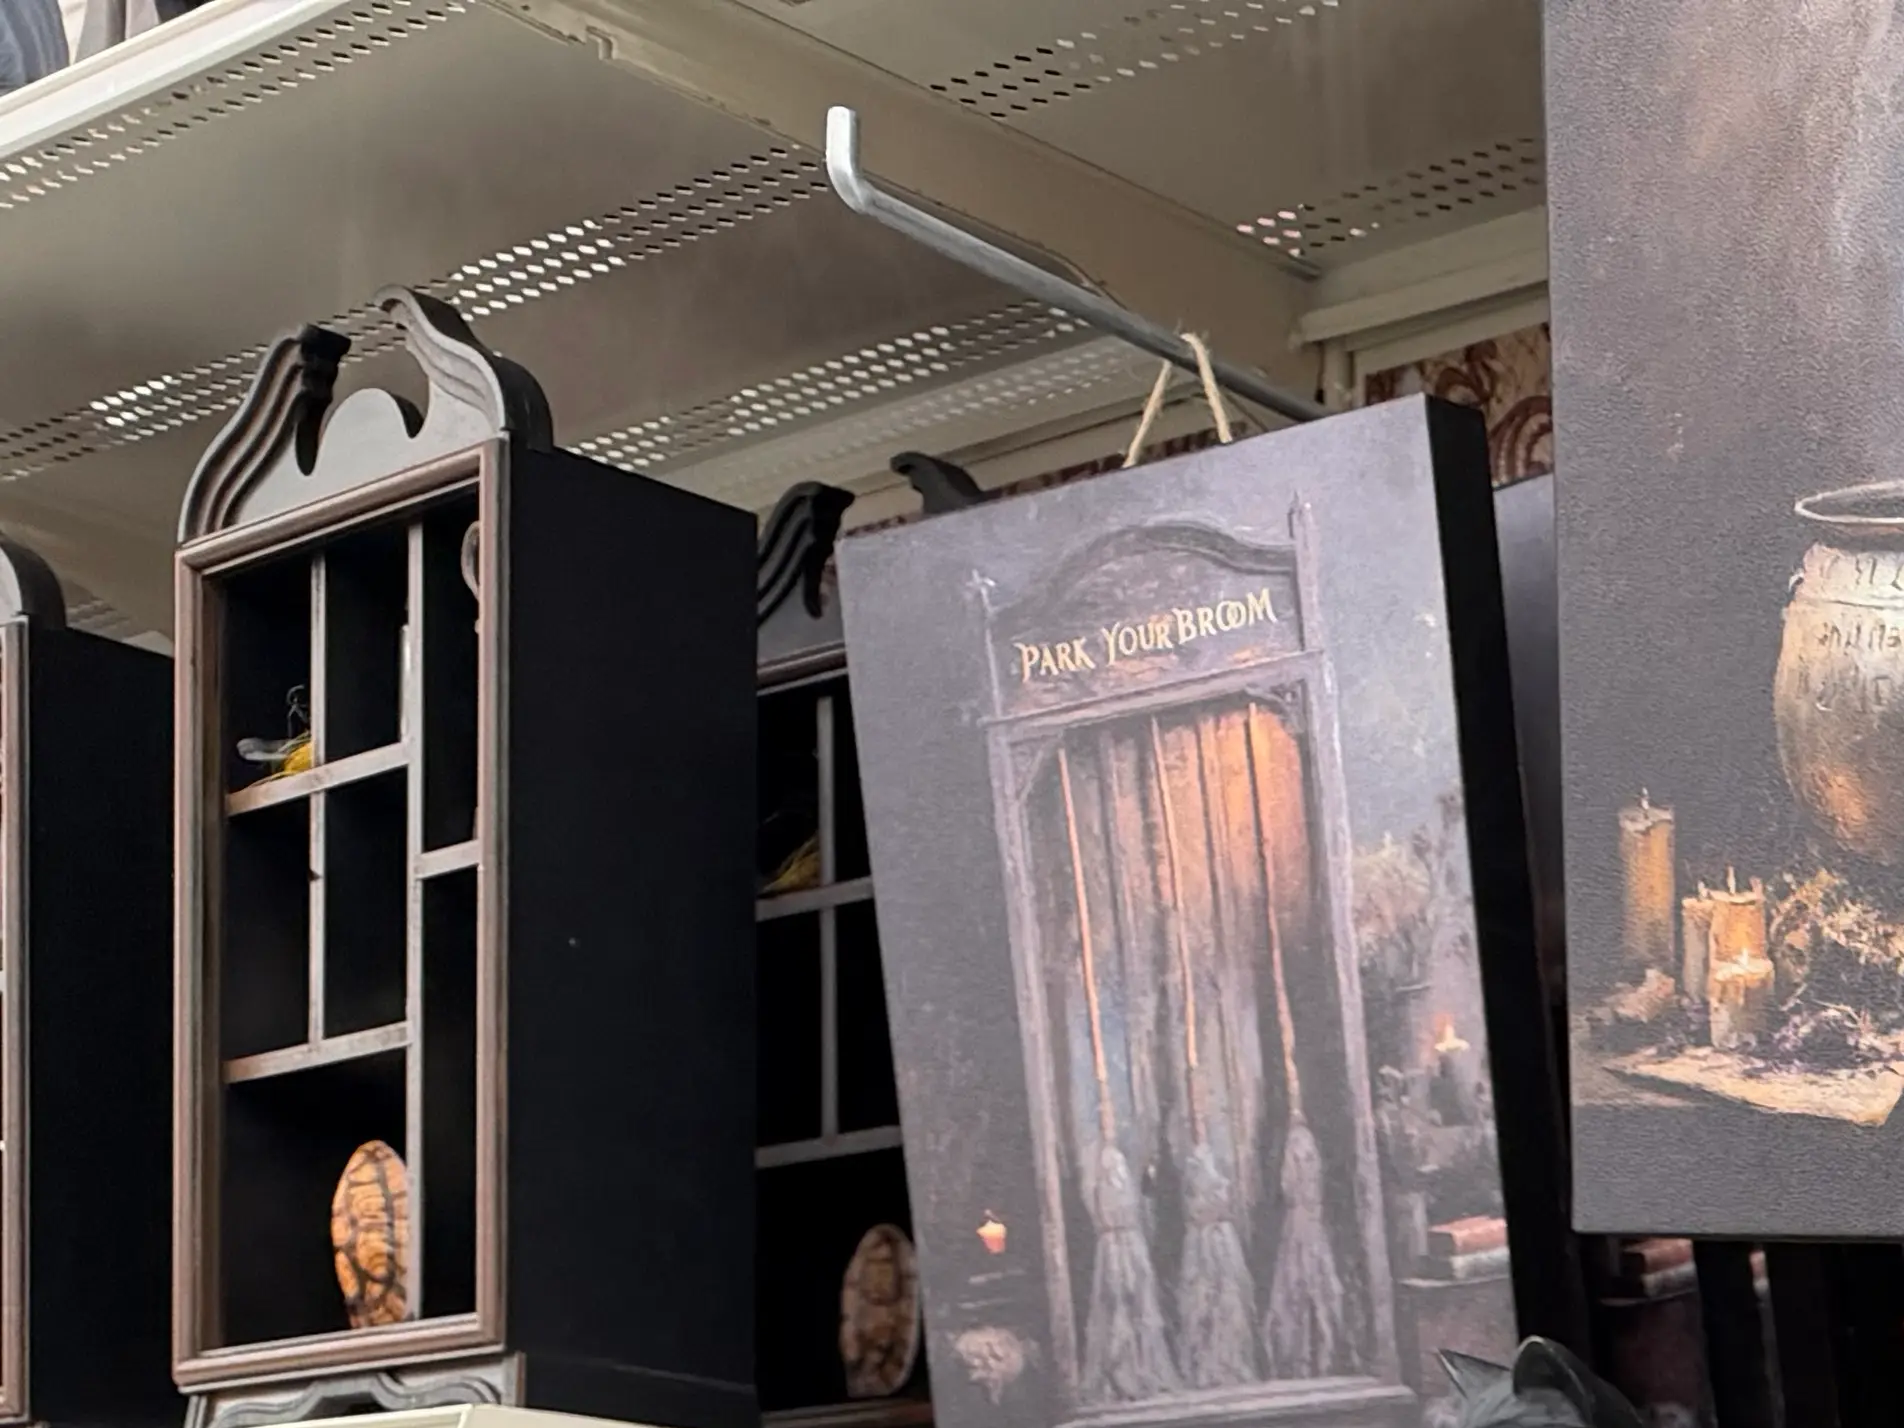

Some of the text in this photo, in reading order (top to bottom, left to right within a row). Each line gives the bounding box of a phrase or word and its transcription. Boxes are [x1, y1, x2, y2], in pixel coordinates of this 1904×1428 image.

[1013, 587, 1279, 683] PARK YOUR BROOM
